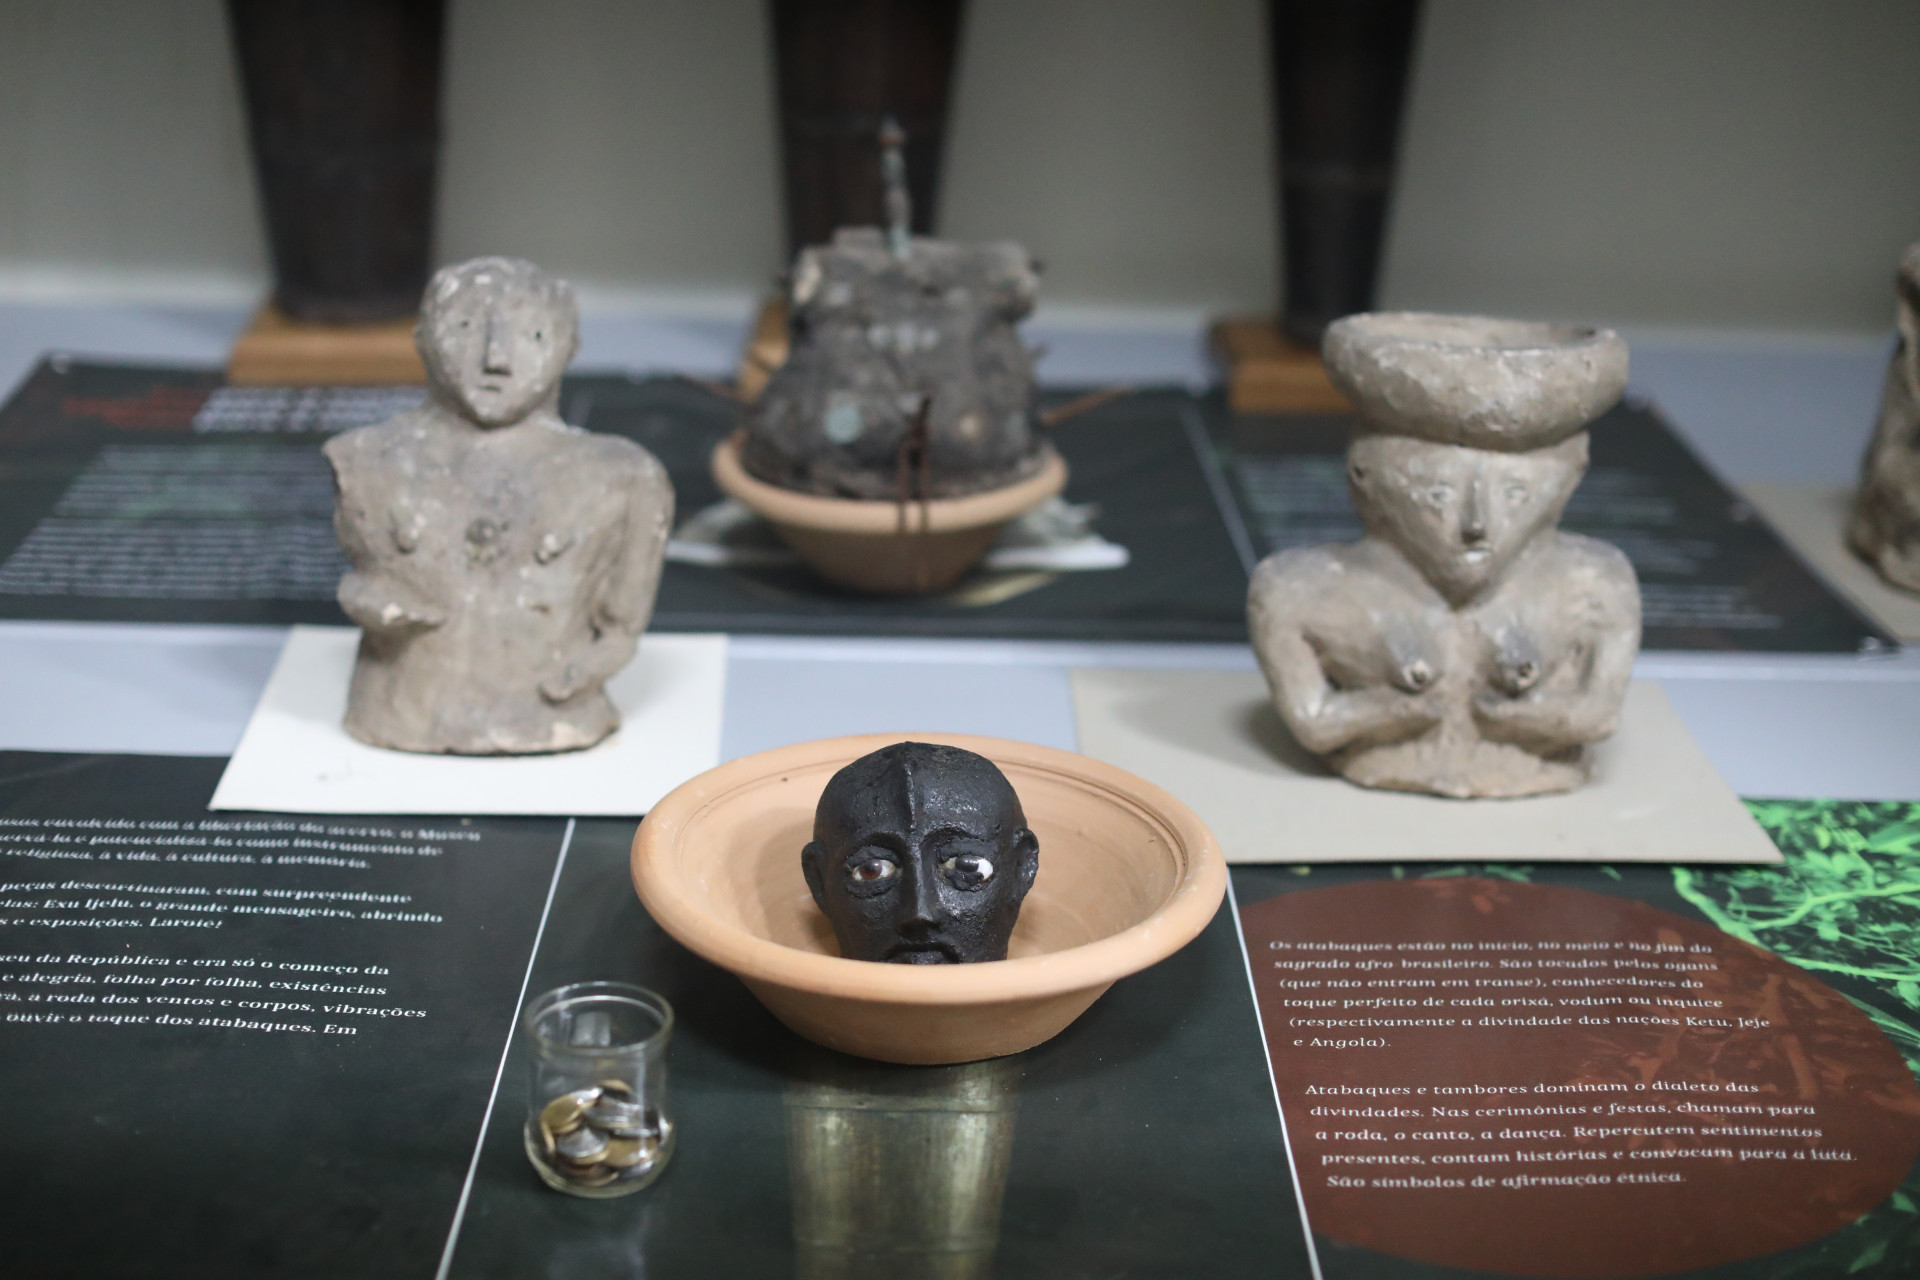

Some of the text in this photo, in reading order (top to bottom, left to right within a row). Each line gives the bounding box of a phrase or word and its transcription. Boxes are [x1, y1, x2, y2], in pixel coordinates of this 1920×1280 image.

[43, 899, 80, 909] Exu
[35, 953, 61, 964] da
[67, 955, 169, 966] República
[175, 958, 188, 966] e
[192, 959, 227, 967] era
[231, 958, 256, 967] só
[260, 961, 273, 969] o
[279, 963, 358, 975] começo
[363, 965, 389, 976] da
[1275, 958, 1718, 971] sagrado afro brasileiro. São tocados pelos ogans
[1, 973, 386, 995] e alegria, folha por folha, existências
[1280, 977, 1704, 990] (que não entram em transe), conhecedores do
[27, 993, 41, 1002] a
[46, 993, 95, 1003] roda
[101, 993, 140, 1004] dos
[146, 997, 214, 1005] ventos
[219, 999, 233, 1007] e
[238, 1001, 315, 1012] corpos,
[324, 1004, 426, 1017] vibrações
[1284, 996, 1722, 1009] toque perfeito de cada orixá, vodum ou inquice
[6, 1013, 357, 1035] ouvir o toque dos atabaques. Em
[1289, 1018, 1455, 1028] (respectivamente
[1461, 1018, 1473, 1027] a
[1479, 1016, 1571, 1026] divindade
[1577, 1015, 1611, 1025] das
[1616, 1016, 1680, 1025] nações
[1738, 1017, 1769, 1028] Jeje
[1293, 1037, 1390, 1049] e Angola).
[1305, 1081, 1760, 1097] Atabaques e tambores dominam o dialeto das
[1310, 1102, 1815, 1118] divindades. Nas cerimônias e festas, chamam para
[1314, 1126, 1822, 1141] a roda, o canto, a dança. Repercutem sentimentos
[1322, 1148, 1856, 1166] presentes, contam histórias e convocam para a luta.
[1326, 1175, 1366, 1188] São
[1470, 1175, 1496, 1188] de
[1501, 1174, 1611, 1189] afirmação
